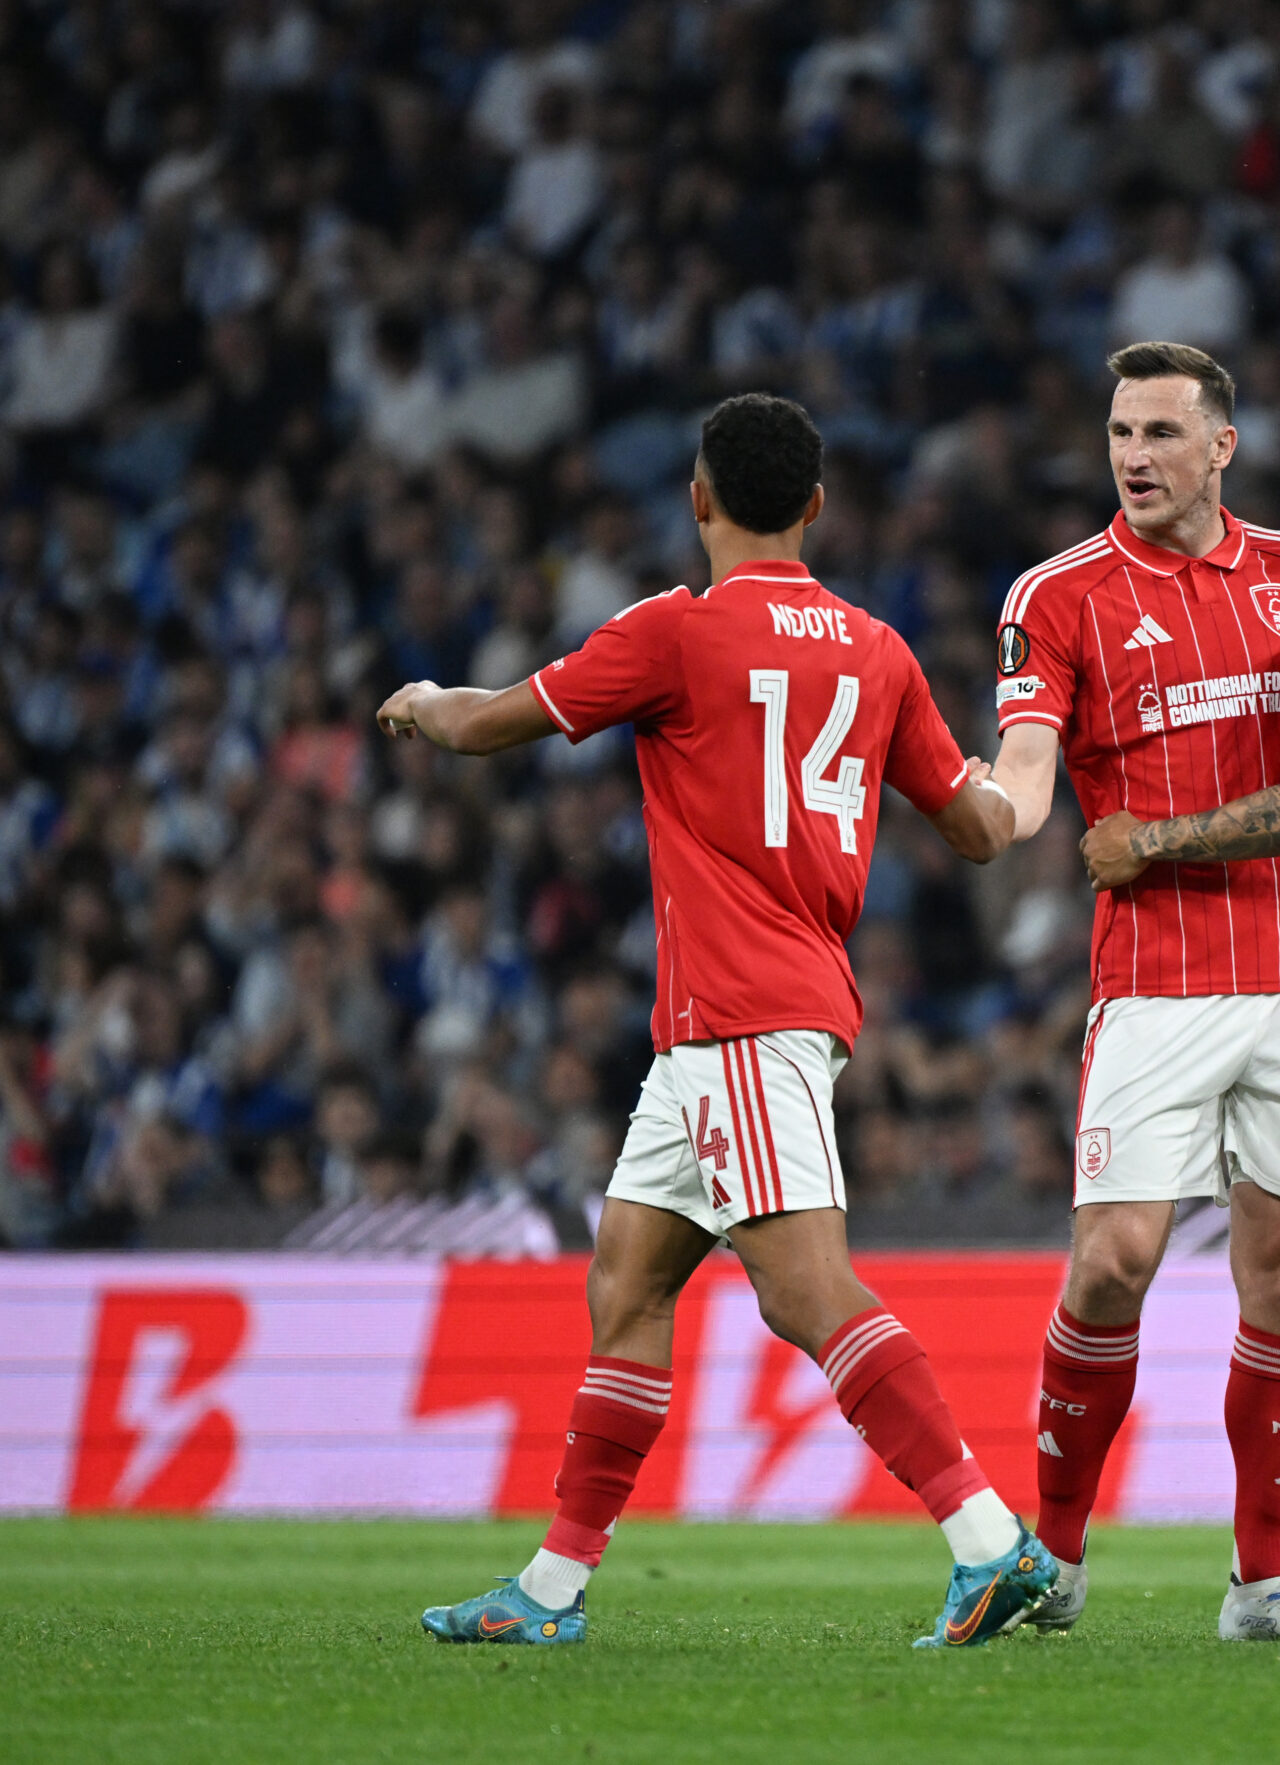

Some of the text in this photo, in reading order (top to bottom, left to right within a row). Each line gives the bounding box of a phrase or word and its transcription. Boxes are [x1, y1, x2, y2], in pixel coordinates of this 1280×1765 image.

[767, 602, 853, 645] NDOYE
[1017, 682, 1034, 693] 10
[1165, 673, 1263, 707] NOTTINGHAM
[1169, 694, 1257, 728] COMMUNITY
[749, 669, 867, 856] 14
[688, 1095, 730, 1172] 4
[1040, 1388, 1087, 1416] FFC
